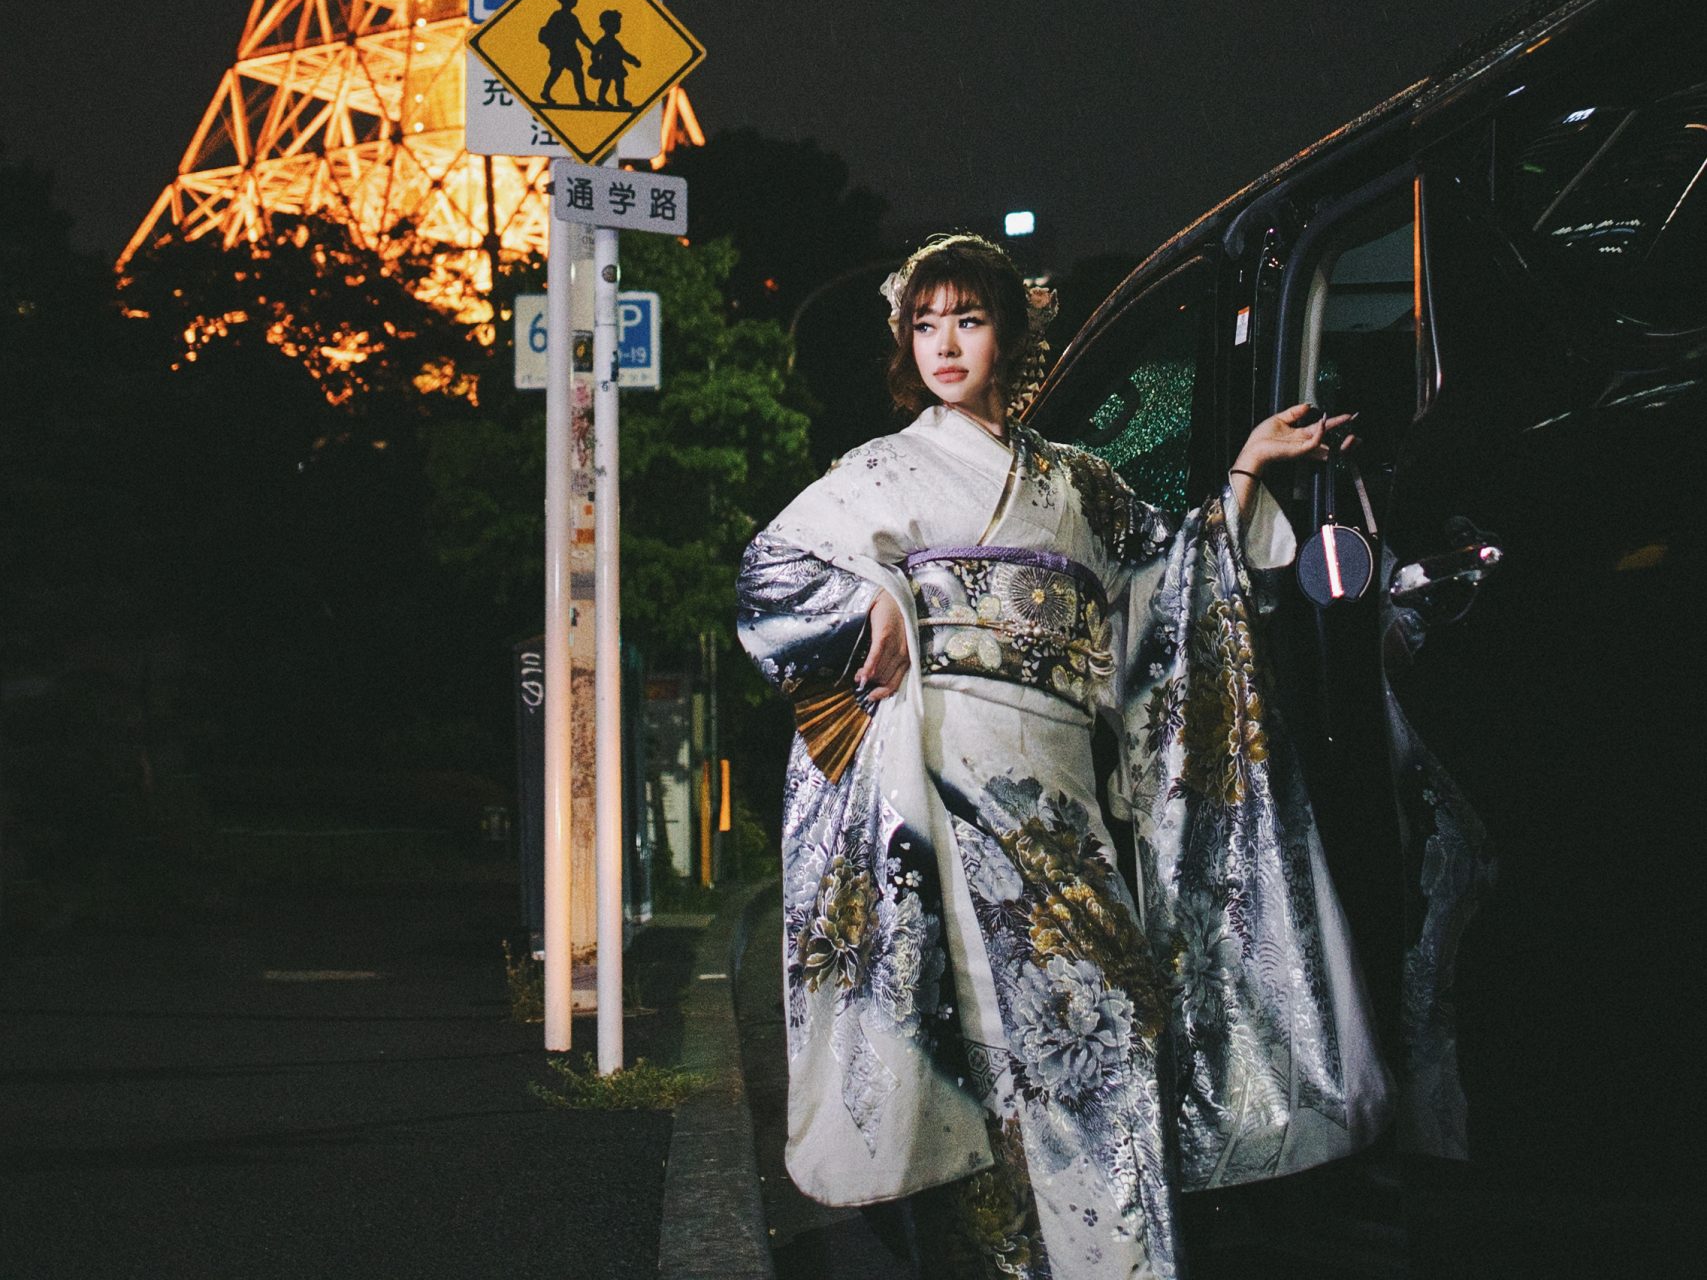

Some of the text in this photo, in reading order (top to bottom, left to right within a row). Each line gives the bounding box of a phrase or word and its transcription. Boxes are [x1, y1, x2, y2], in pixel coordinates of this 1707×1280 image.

[566, 177, 677, 221] 通学路
[619, 304, 642, 342] P
